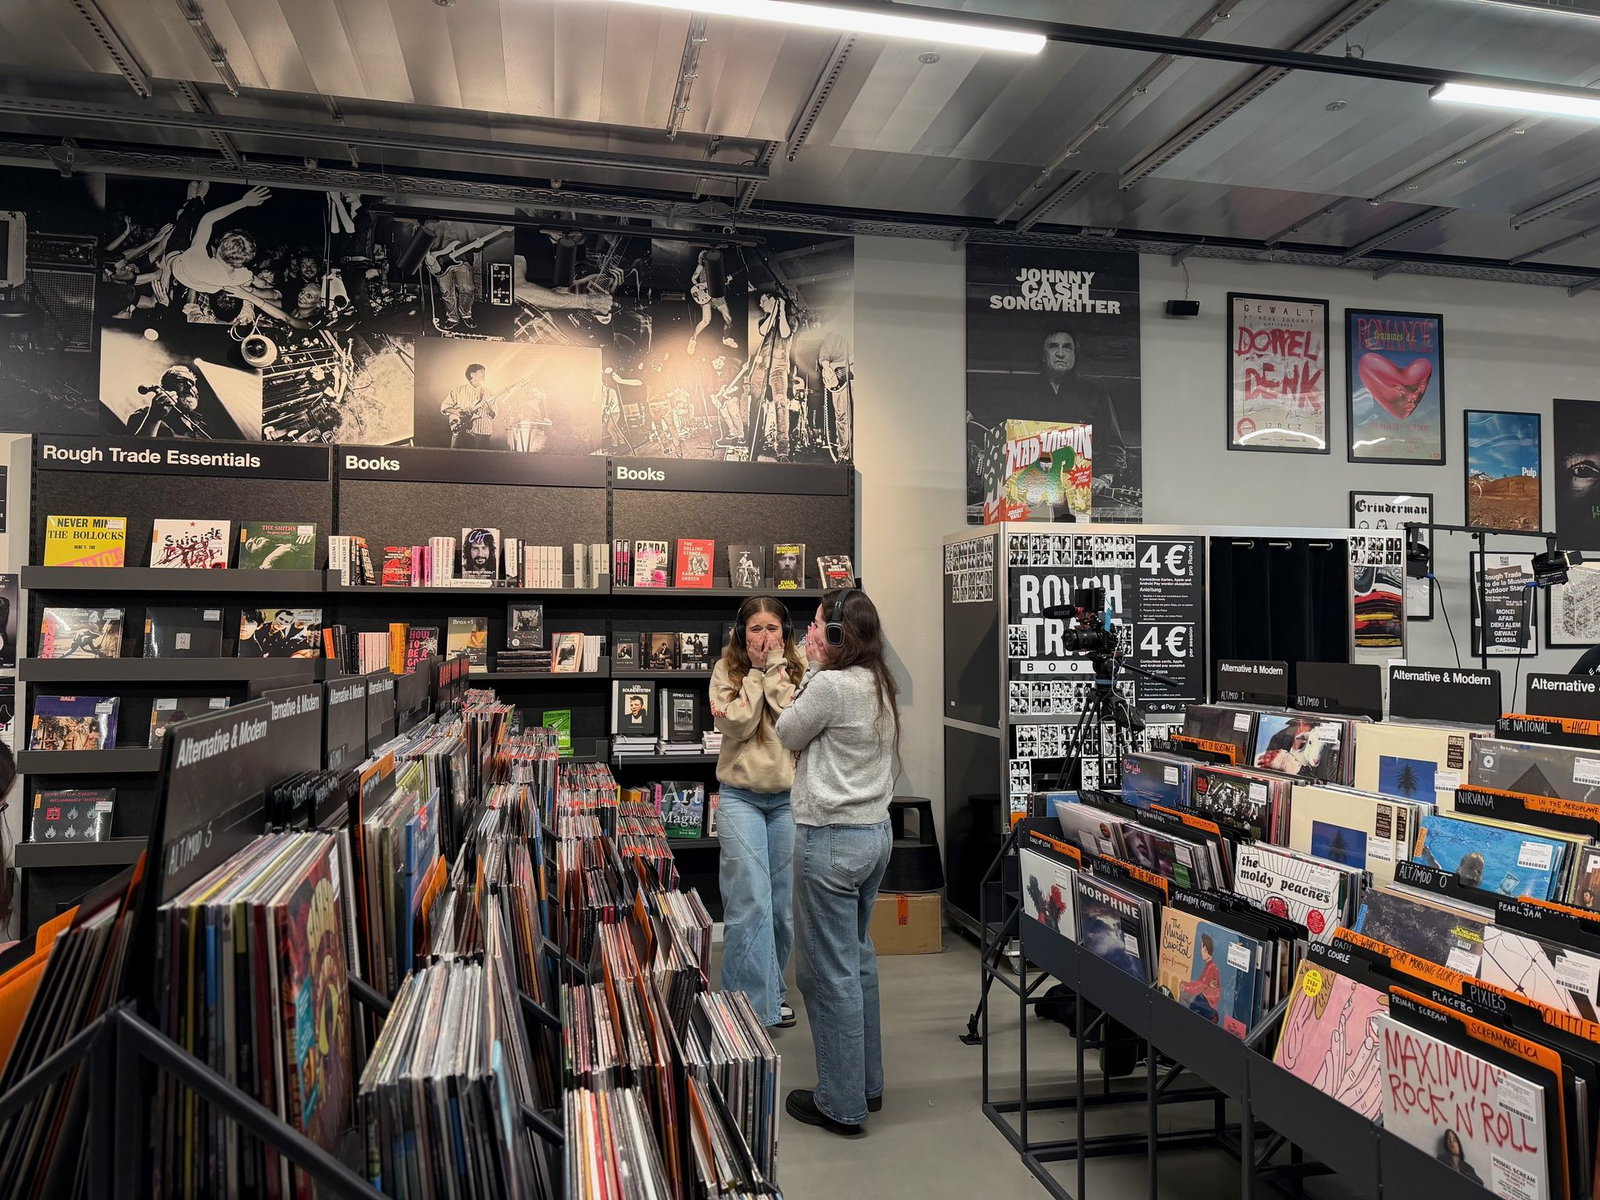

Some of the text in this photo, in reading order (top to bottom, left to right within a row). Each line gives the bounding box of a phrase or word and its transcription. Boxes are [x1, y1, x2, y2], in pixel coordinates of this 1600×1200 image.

[1016, 268, 1095, 285] JOHNNY
[1021, 280, 1090, 301] CASH
[989, 294, 1121, 315] SONGWRITER
[1244, 304, 1314, 317] GEWALT
[1356, 318, 1435, 353] ROMANCE
[1244, 360, 1323, 411] DENK
[42, 445, 261, 469] Rough Trade Essentials
[345, 455, 401, 471] Books
[616, 466, 665, 481] Books
[1521, 466, 1537, 479] Pulp
[1355, 499, 1428, 515] Grinderman
[57, 518, 89, 528] NEVER
[48, 530, 124, 540] THE BOLLOCKS
[637, 542, 666, 554] PANDA
[1504, 571, 1522, 579] Trade
[409, 630, 430, 639] HOW
[409, 640, 420, 648] TO
[407, 649, 428, 658] BE A
[1221, 664, 1284, 676] Alternative & Modern
[1392, 669, 1492, 686] Alternative & Modern
[1531, 678, 1596, 693] Alternative
[329, 687, 350, 706] Alternative
[353, 684, 365, 699] Modern
[1297, 695, 1328, 708] ALT/MOD L
[296, 693, 320, 715] & Modern
[1496, 719, 1551, 735] THE NATIONAL
[176, 718, 268, 769] Alternative & Modern
[661, 781, 702, 803] Art
[1458, 791, 1495, 809] NIRVANA
[1539, 798, 1600, 815] IN THE AEROPLANE
[660, 811, 701, 826] Magic
[205, 821, 213, 849] S
[1241, 856, 1258, 869] the
[1240, 869, 1274, 887] moldy
[1399, 864, 1433, 885] ALT/MOD
[1079, 882, 1140, 920] MORPHINE
[1498, 901, 1522, 915] PEARL
[1523, 908, 1542, 919] JAM
[1170, 917, 1181, 929] The
[1164, 921, 1192, 946] Murder
[1162, 936, 1192, 959] Capital
[1311, 942, 1351, 965] ODD COUPLE
[1333, 939, 1353, 952] OASIS
[1409, 957, 1435, 977] MORNING
[1432, 989, 1474, 1014] PLACEBO
[1470, 985, 1507, 1012] PIXIES
[1391, 993, 1448, 1024] PRIMAL SCREAM
[1492, 1156, 1536, 1184] PRIMAL SCREAM
